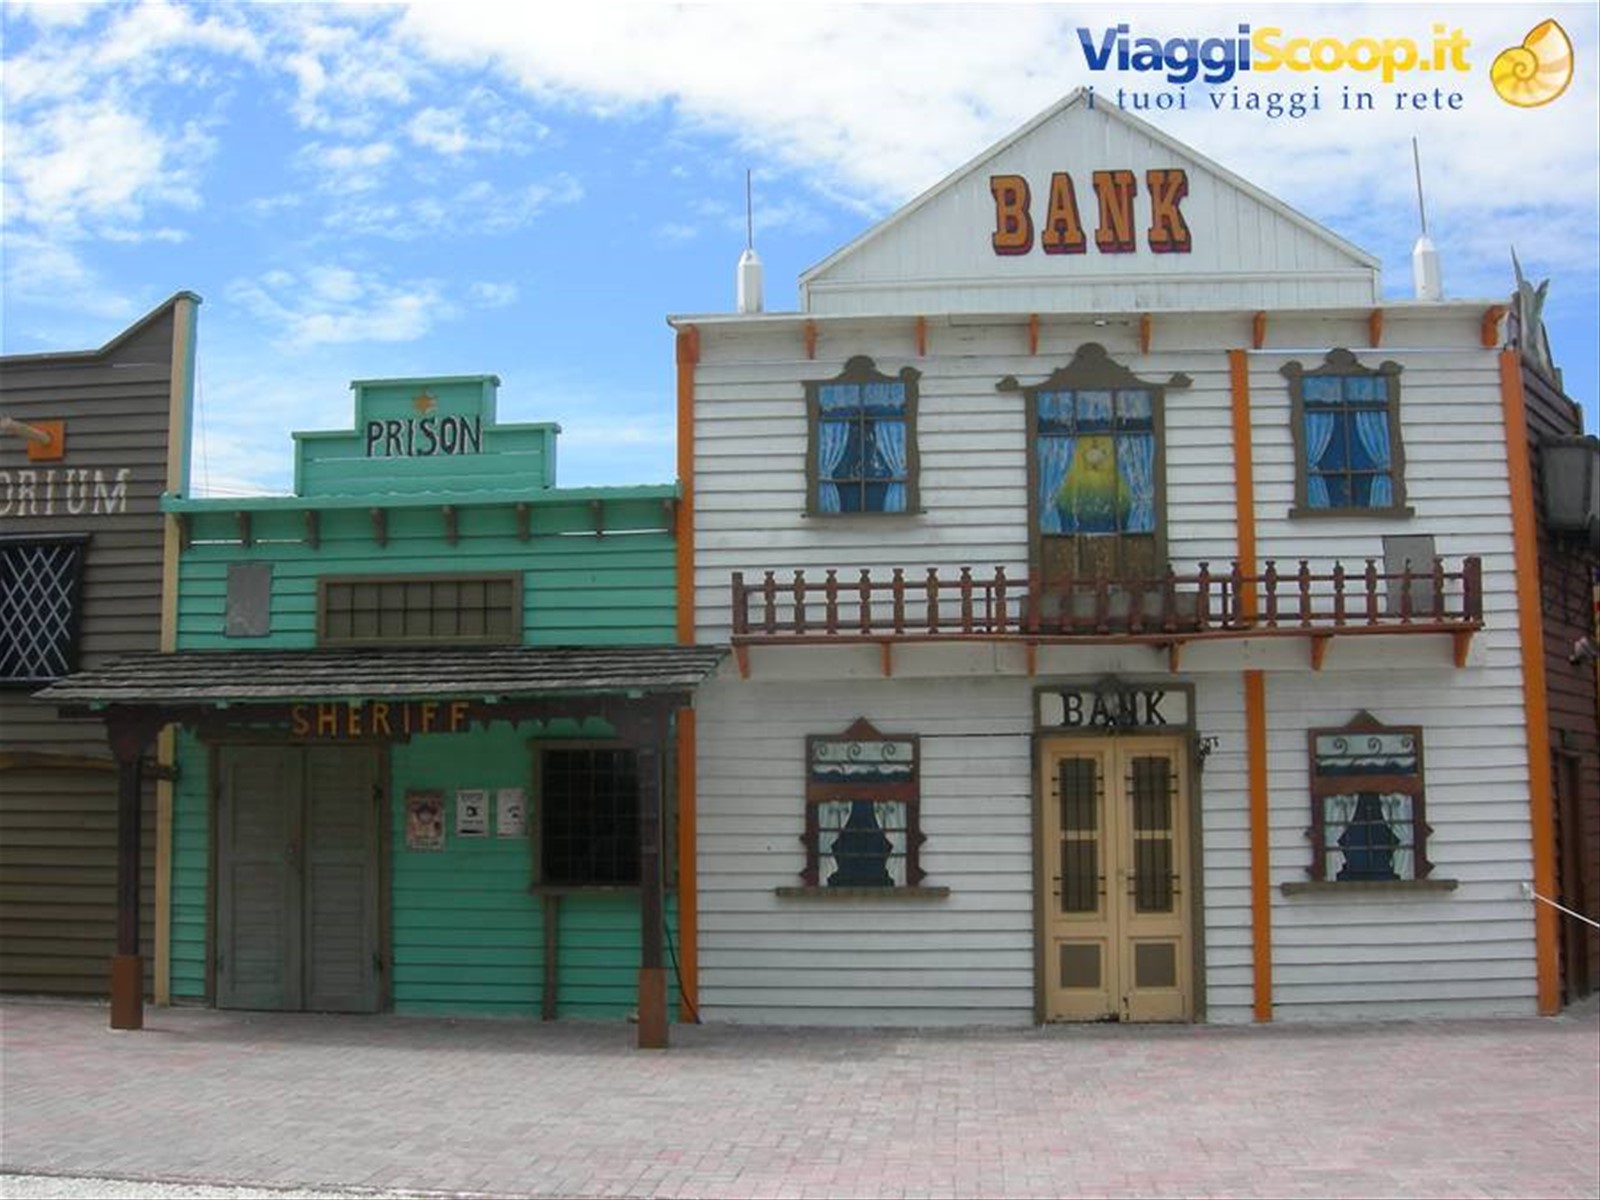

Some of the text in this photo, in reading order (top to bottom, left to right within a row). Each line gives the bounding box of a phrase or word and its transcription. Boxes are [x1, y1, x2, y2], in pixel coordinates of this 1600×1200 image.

[990, 169, 1192, 256] BANK
[366, 414, 482, 457] PRISON
[292, 702, 470, 736] SHERIFF
[1061, 691, 1167, 727] BANK
